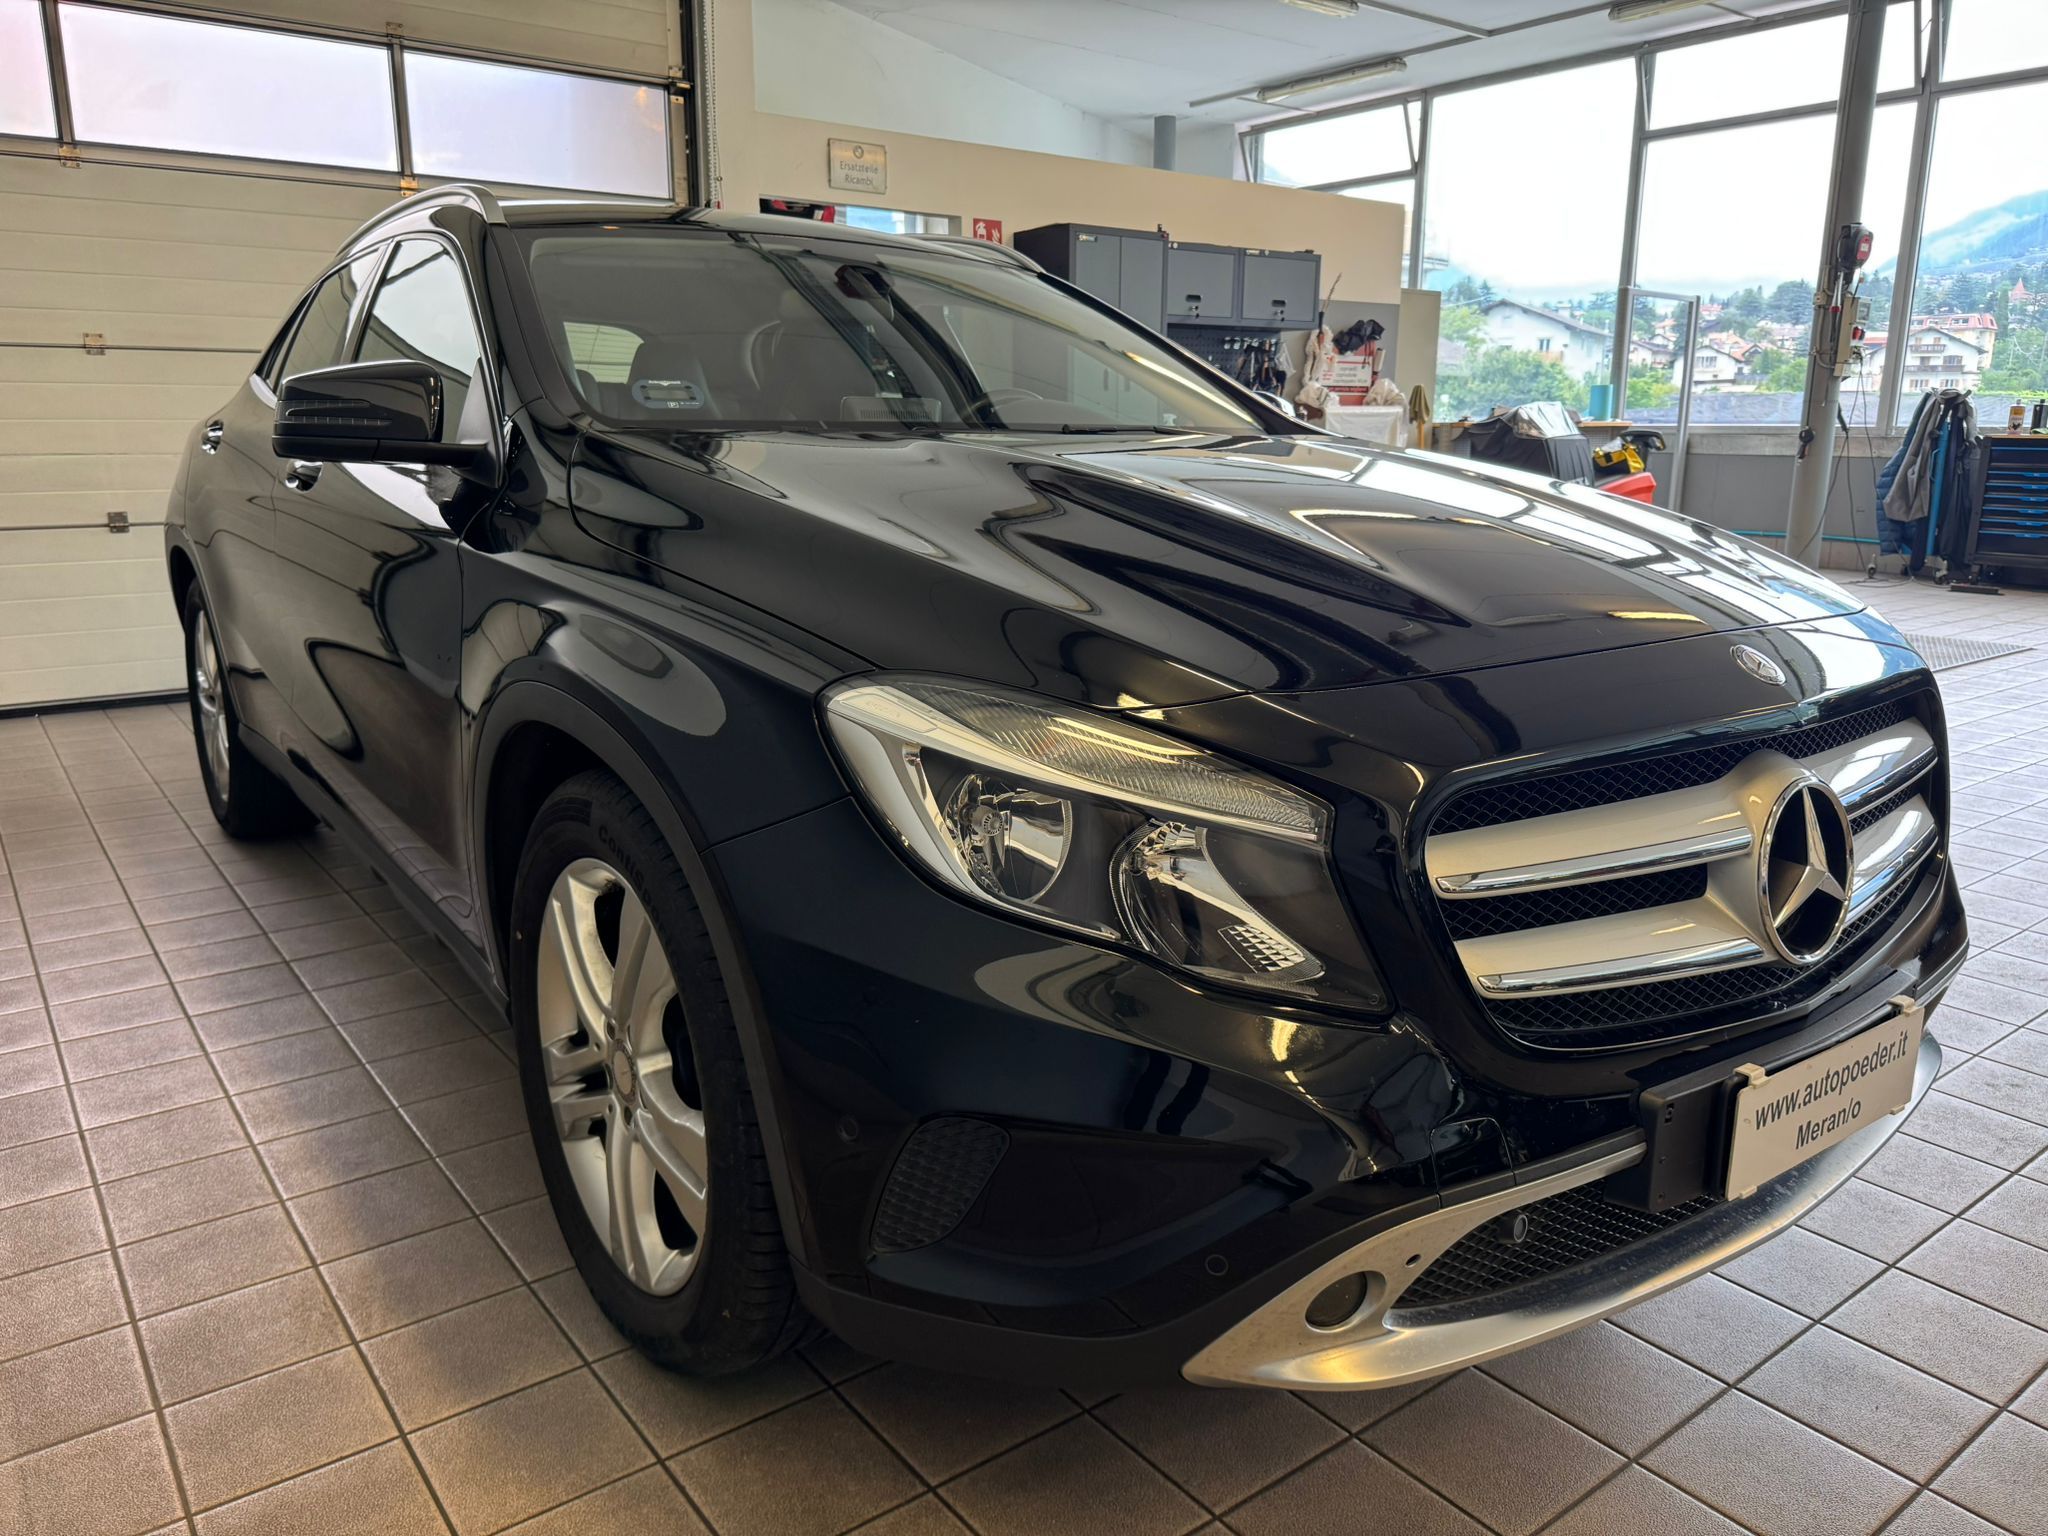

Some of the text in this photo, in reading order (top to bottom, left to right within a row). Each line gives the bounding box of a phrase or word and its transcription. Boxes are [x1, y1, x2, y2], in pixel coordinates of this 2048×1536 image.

[840, 160, 879, 174] Ersatzteile
[845, 174, 874, 186] Ricambi
[1755, 1030, 1908, 1130] www.autopoeder.it
[1795, 1097, 1862, 1149] Meran/o
